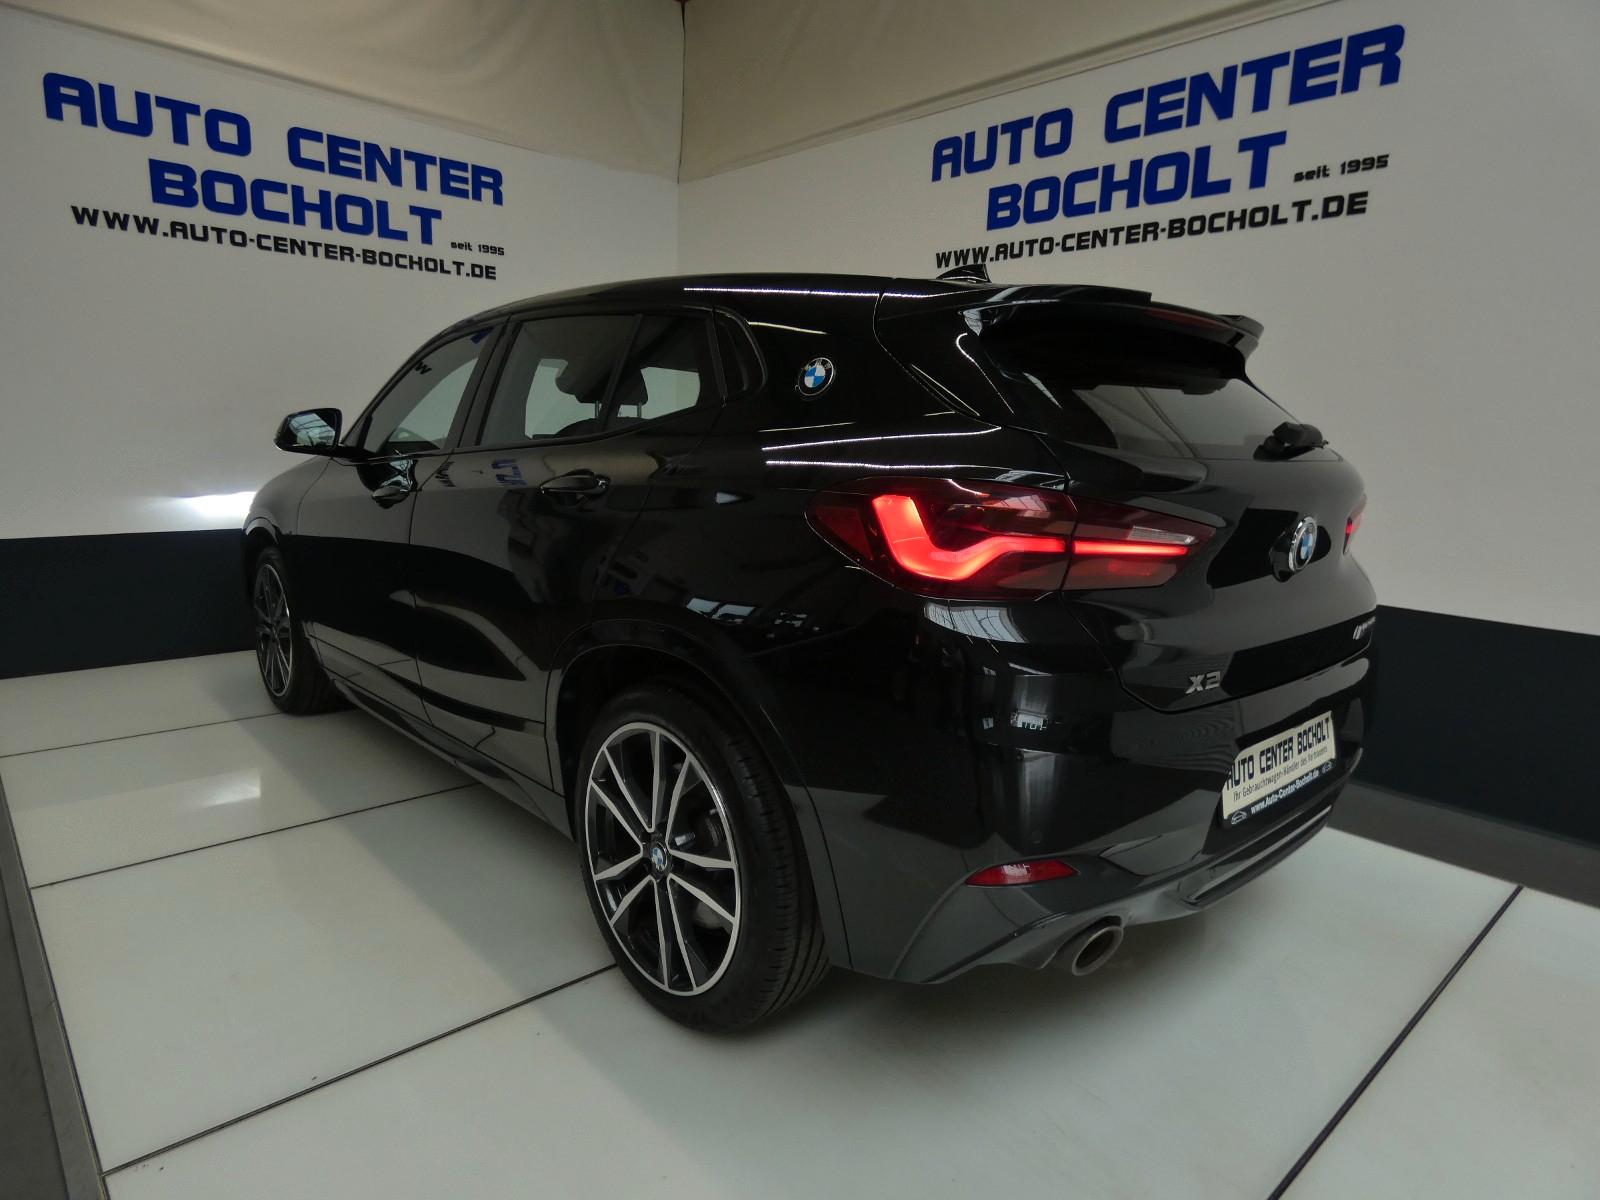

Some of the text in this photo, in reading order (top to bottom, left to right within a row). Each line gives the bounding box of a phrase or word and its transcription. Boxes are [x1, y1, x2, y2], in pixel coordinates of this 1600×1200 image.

[43, 72, 504, 206] AUTO CENTER
[931, 24, 1406, 182] AUTO CENTER
[148, 158, 443, 245] BOCHOLT
[986, 130, 1288, 231] BOCHOLT
[1294, 153, 1390, 183] seit 1995
[450, 241, 505, 256] seit 1995
[1227, 717, 1330, 791] AUTO CENTER BOCHOLT
